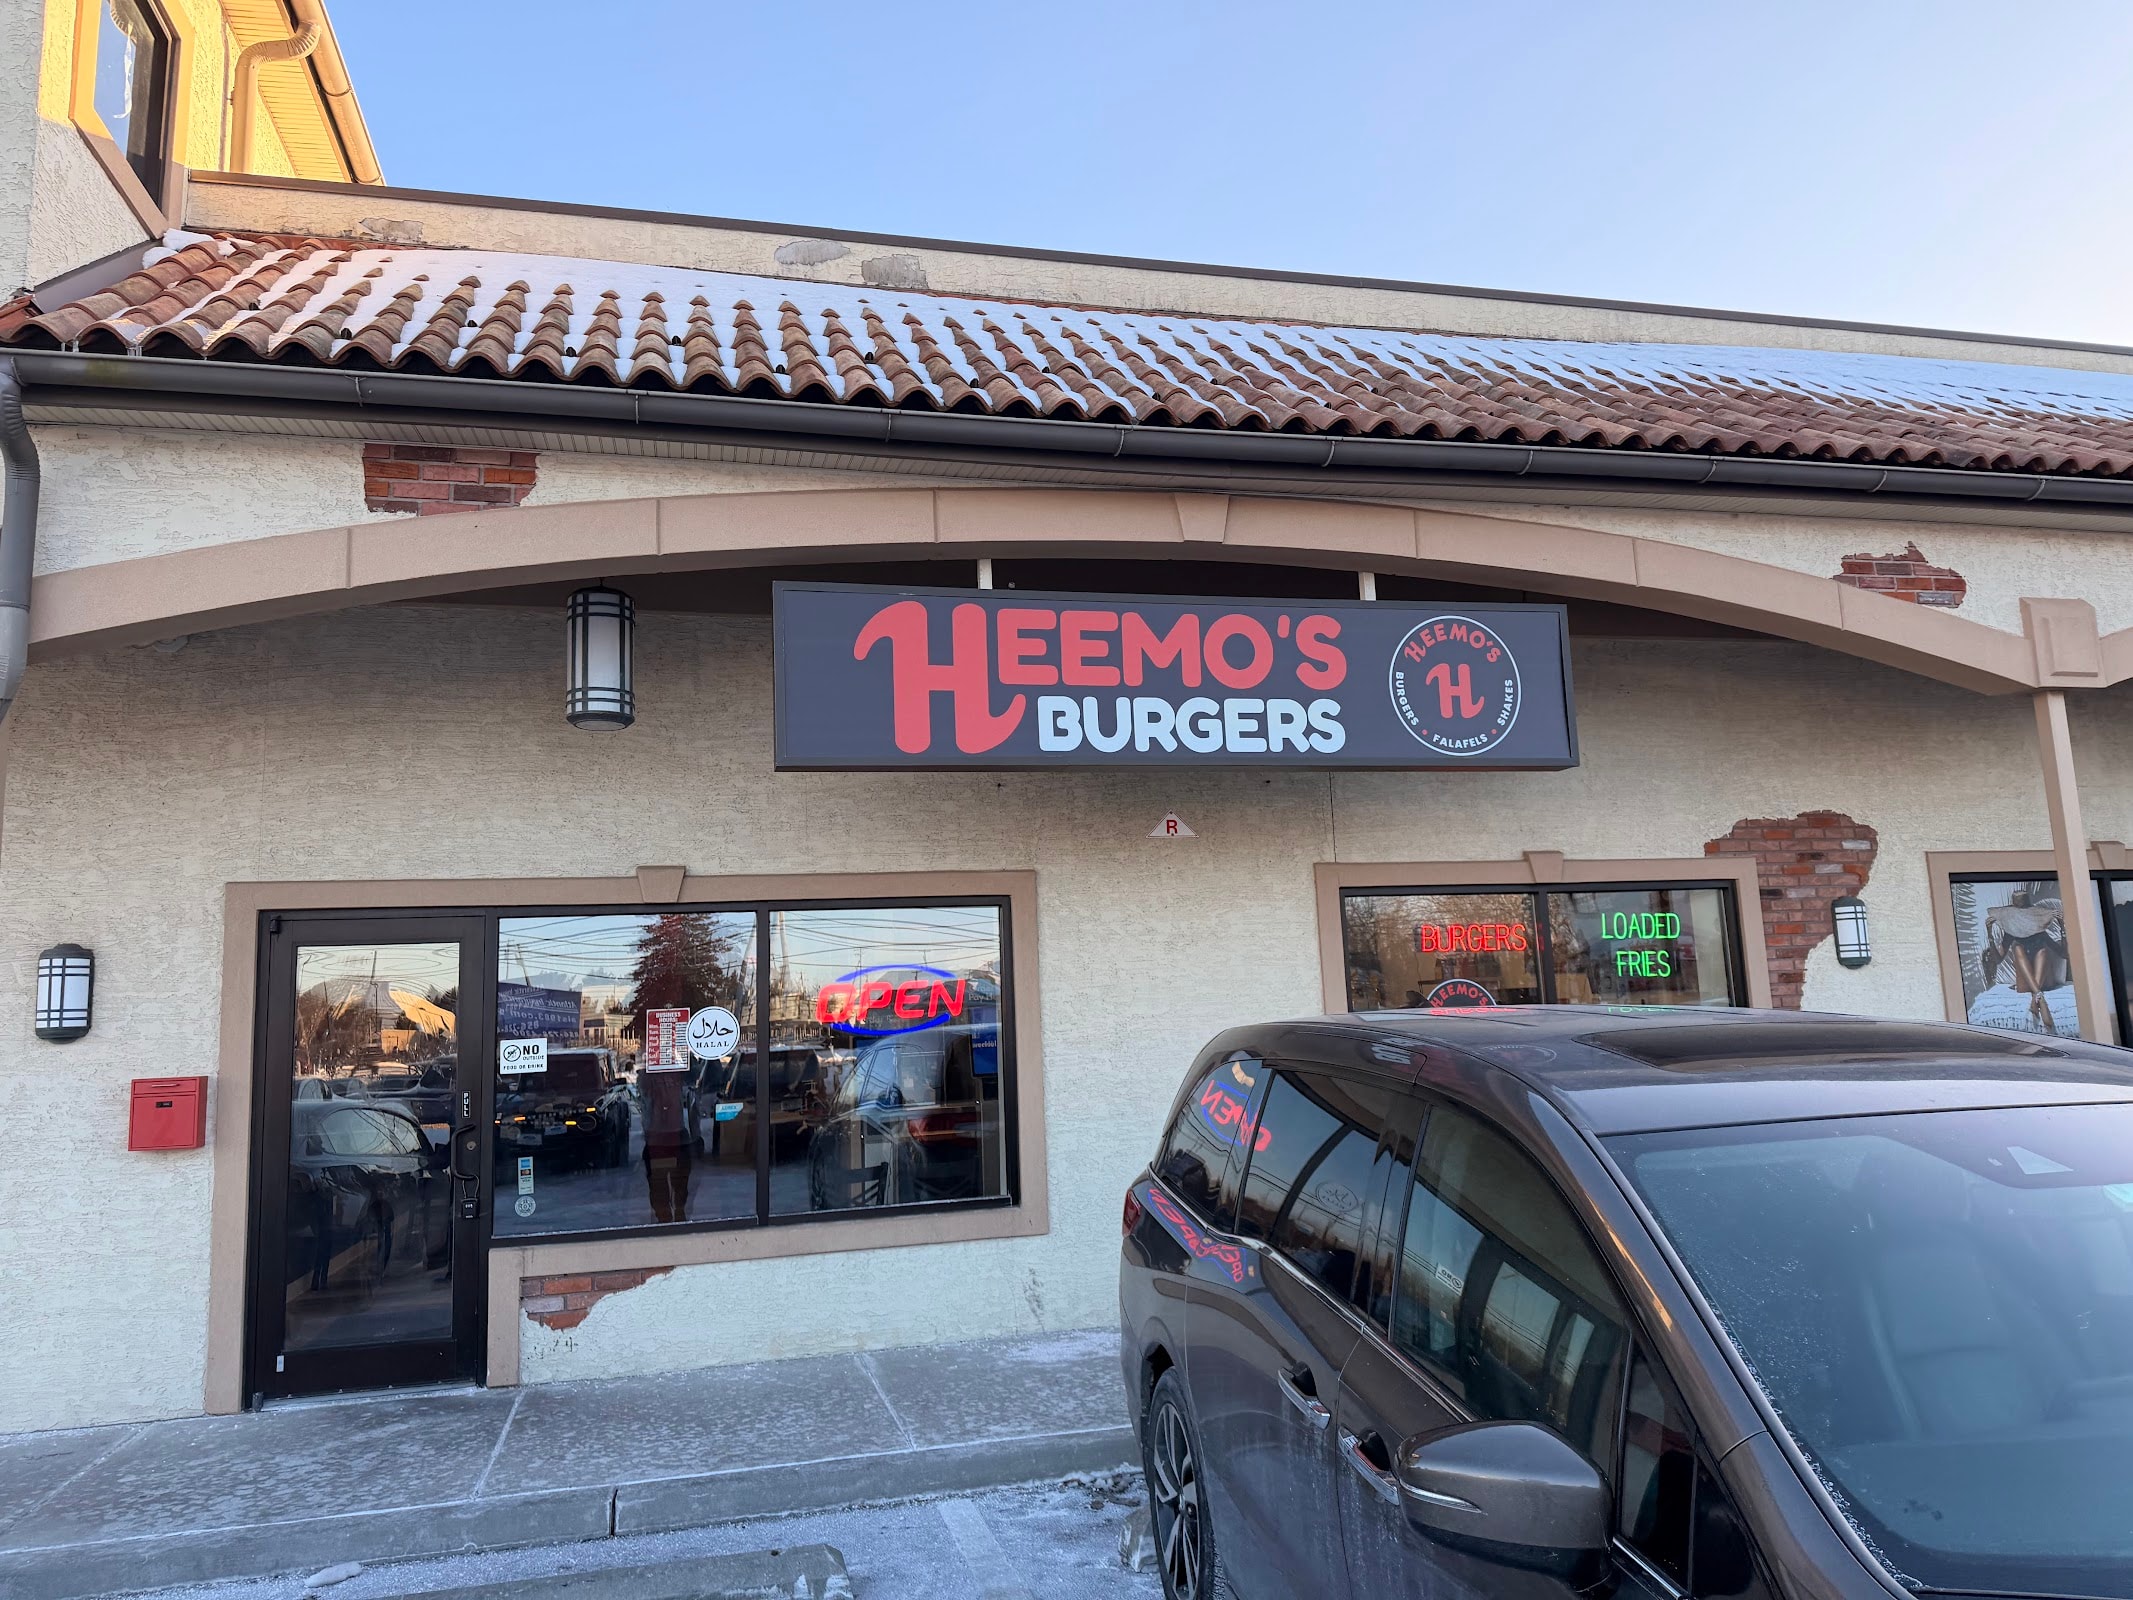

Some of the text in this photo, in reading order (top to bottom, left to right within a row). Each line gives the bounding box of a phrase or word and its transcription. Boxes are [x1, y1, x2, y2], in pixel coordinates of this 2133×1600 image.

[1404, 623, 1501, 663] HEEMO'S
[853, 600, 1348, 754] HEEMO'S
[1425, 662, 1485, 719] H
[1395, 671, 1420, 726] BURGERS
[1497, 679, 1514, 726] SHAKES
[1037, 695, 1346, 754] BURGERS
[1432, 733, 1488, 749] FALAFELS
[1166, 819, 1178, 834] R
[1420, 923, 1528, 953] BURGERS
[1601, 912, 1681, 940] LOADED
[1615, 950, 1671, 978] FRIES
[815, 978, 966, 1023] OPEN
[1431, 984, 1489, 1007] HEEMO'S
[692, 1017, 734, 1039] حلال
[522, 1044, 540, 1055] NO
